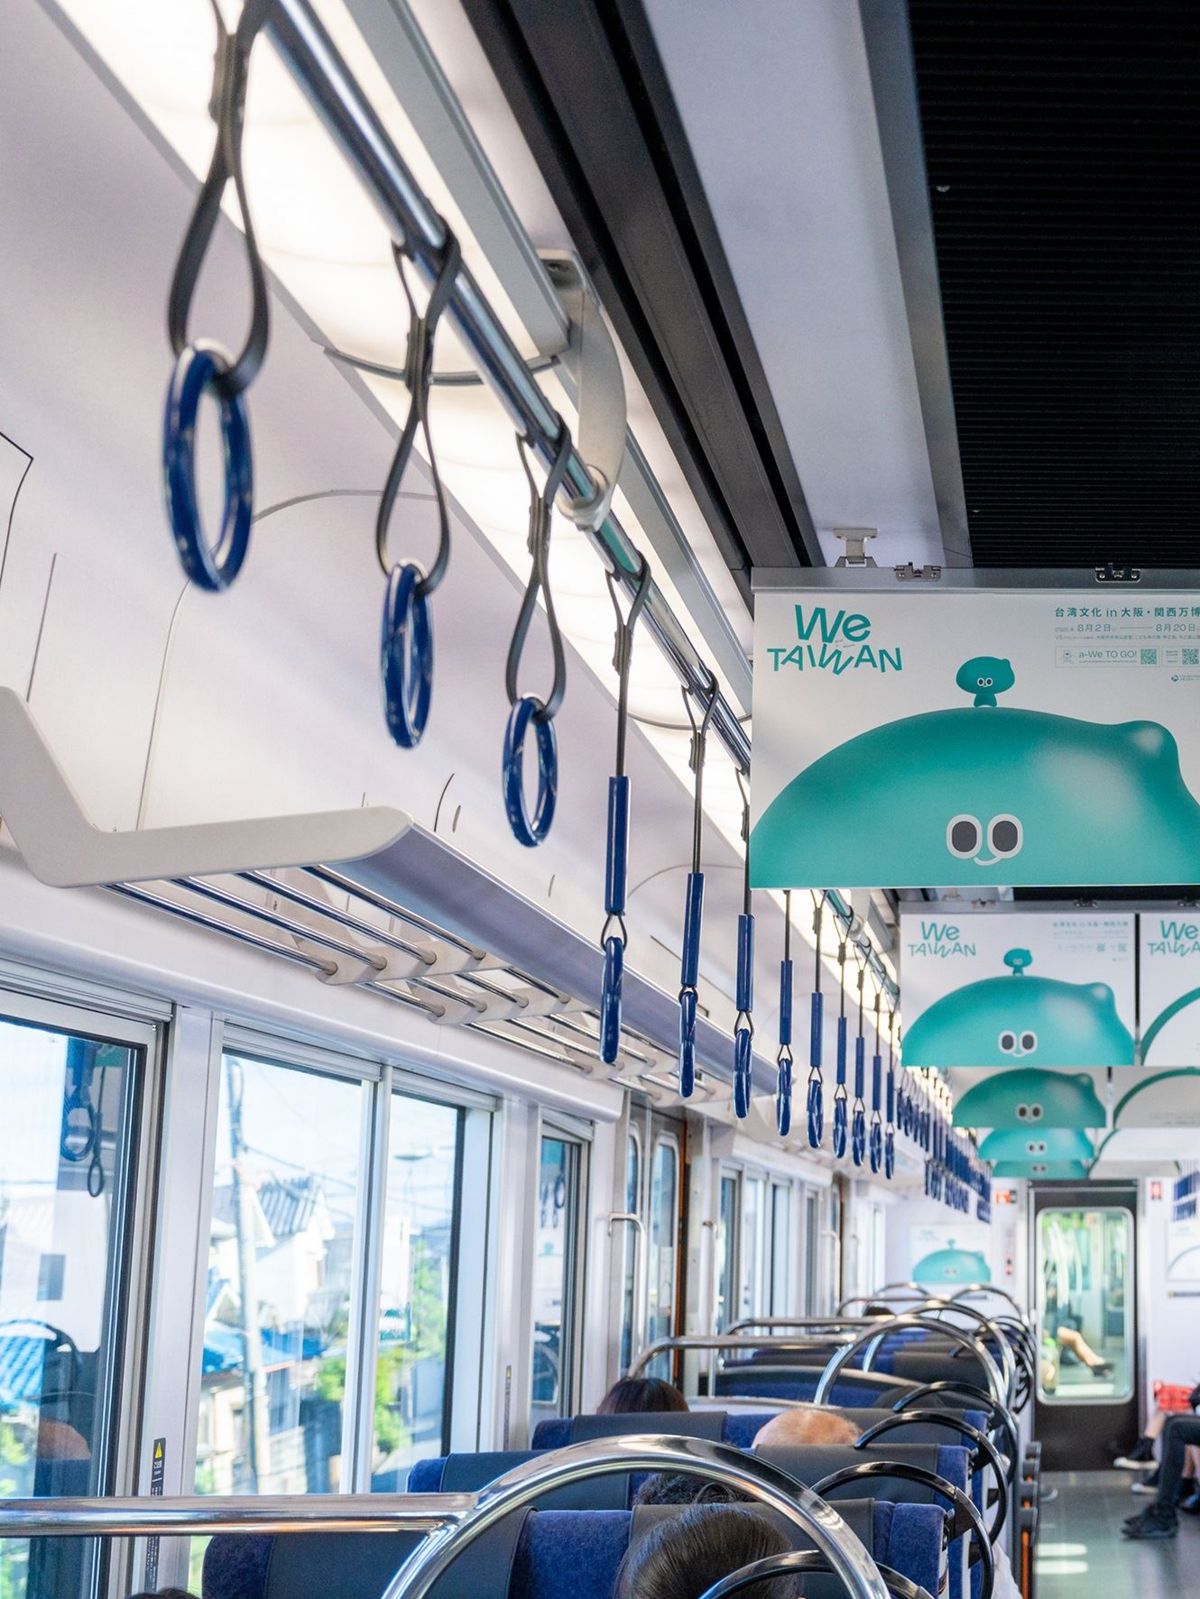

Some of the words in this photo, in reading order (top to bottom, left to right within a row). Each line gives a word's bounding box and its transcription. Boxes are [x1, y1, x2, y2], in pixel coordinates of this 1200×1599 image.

[1055, 607, 1102, 617] 台湾文化
[1106, 607, 1118, 617] in
[794, 604, 872, 643] We
[767, 643, 902, 675] TAIWAN
[921, 921, 960, 941] We
[1160, 920, 1199, 940] We
[908, 942, 977, 958] TAIWAN
